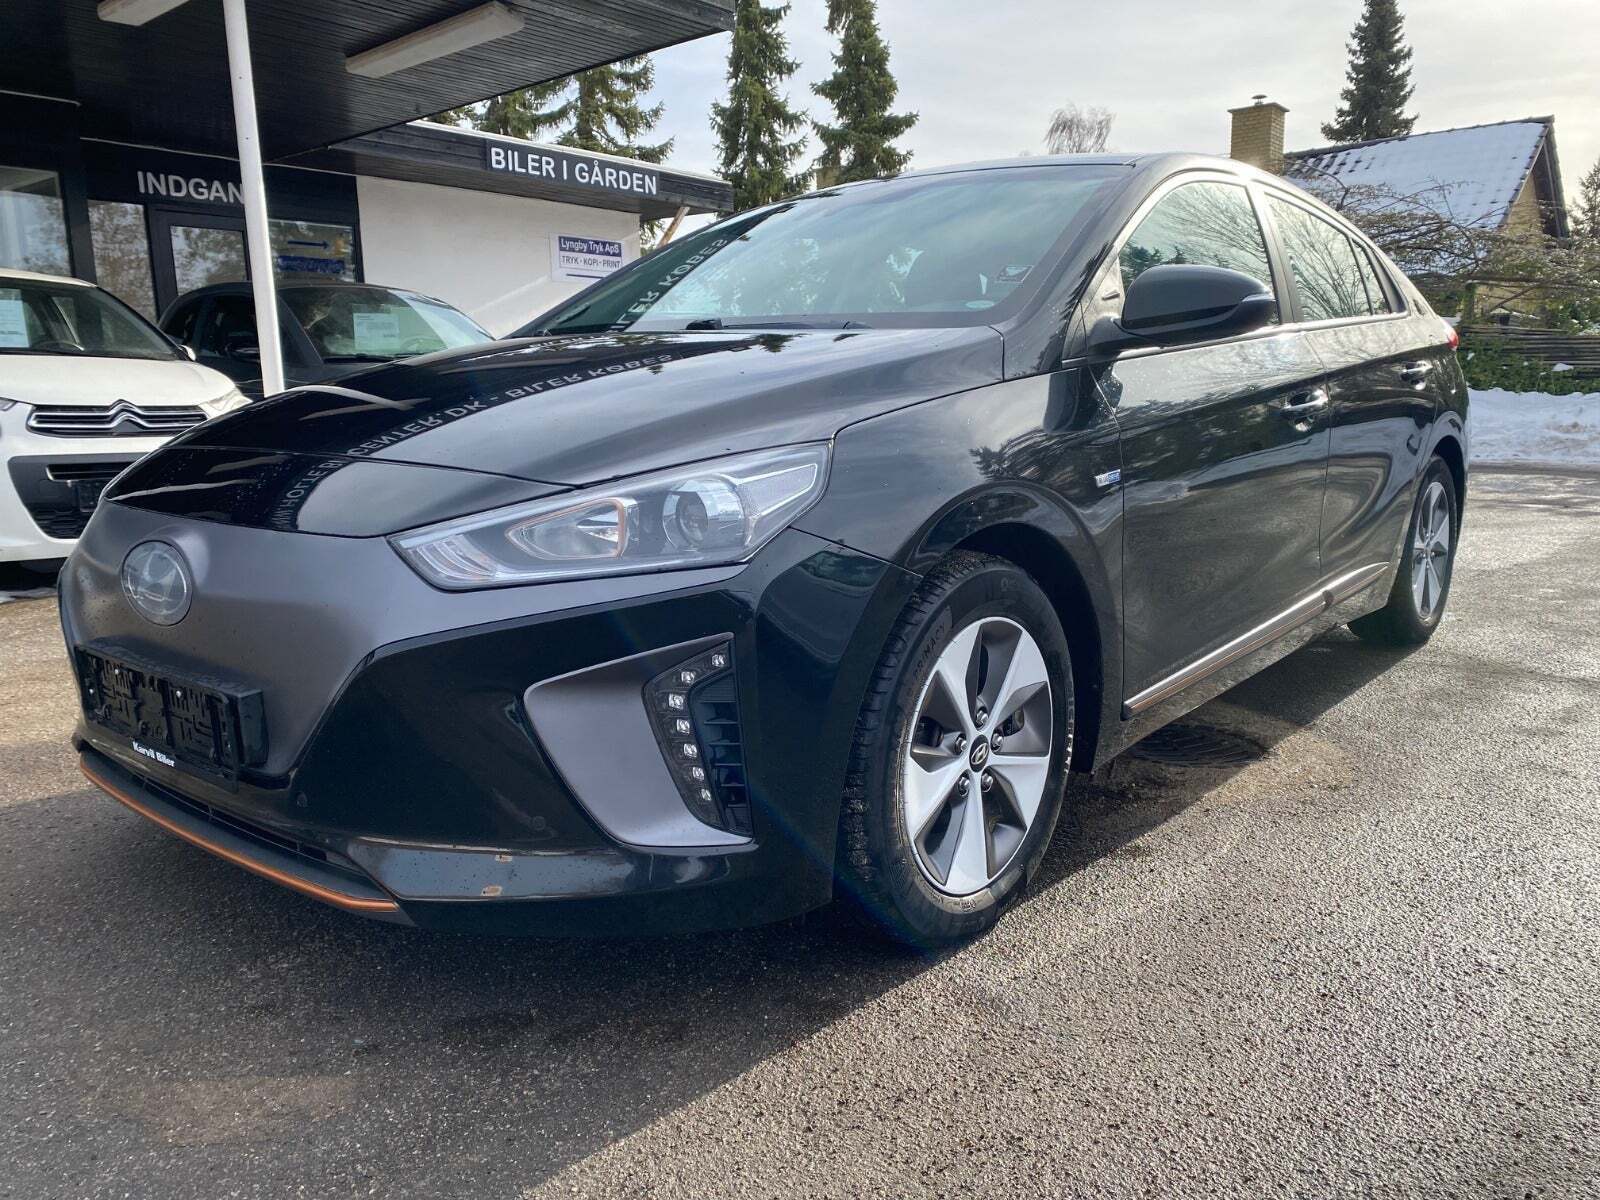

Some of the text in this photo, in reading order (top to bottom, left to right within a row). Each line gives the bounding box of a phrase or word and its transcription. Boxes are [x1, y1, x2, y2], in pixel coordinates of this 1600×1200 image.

[491, 147, 657, 195] BILER I GÅRDEN
[137, 170, 244, 204] INDGAN
[561, 238, 620, 255] Lyngby Tryk ApS
[562, 256, 620, 269] TRYK KOPI PRINT
[155, 751, 176, 767] Biler
